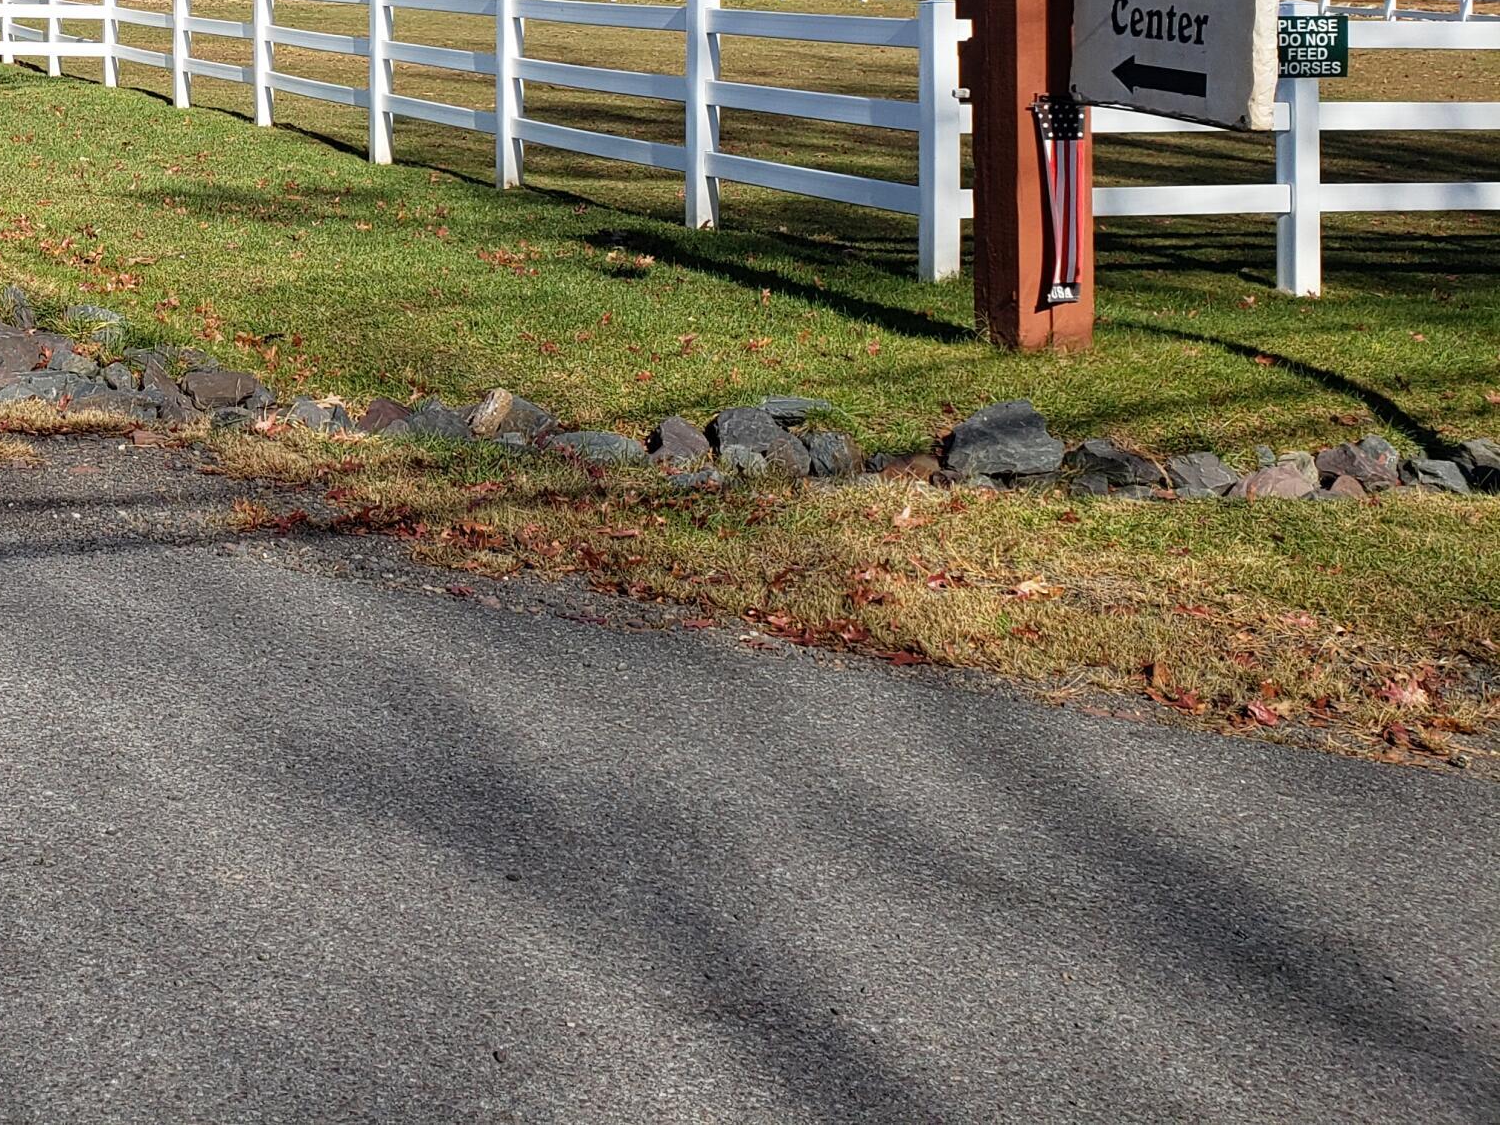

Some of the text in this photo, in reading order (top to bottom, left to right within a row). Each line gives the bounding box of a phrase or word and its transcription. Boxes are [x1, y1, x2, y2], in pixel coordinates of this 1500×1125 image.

[1278, 18, 1338, 32] PLEASE
[1279, 33, 1338, 46] DO NOT
[1288, 47, 1328, 60] FEED
[1278, 61, 1342, 75] HORSES
